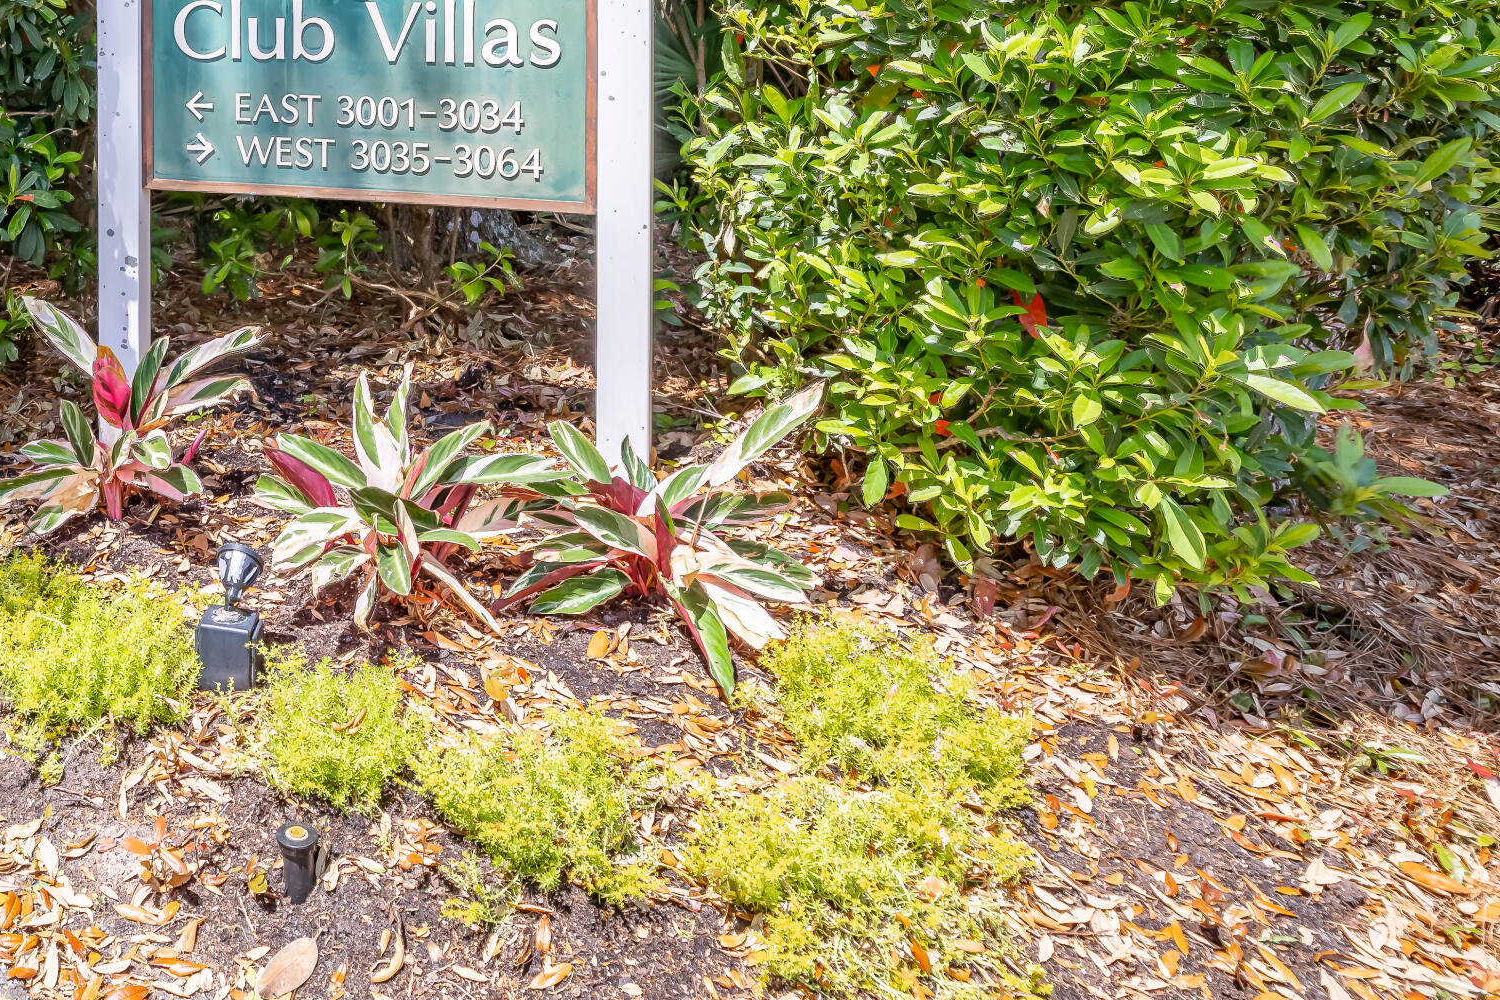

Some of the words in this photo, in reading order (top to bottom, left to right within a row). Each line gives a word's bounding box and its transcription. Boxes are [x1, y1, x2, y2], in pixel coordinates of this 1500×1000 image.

[234, 93, 321, 125] EAST
[336, 95, 524, 134] 3001-3034
[235, 135, 336, 169] WEST
[350, 139, 544, 181] 3035-3064
